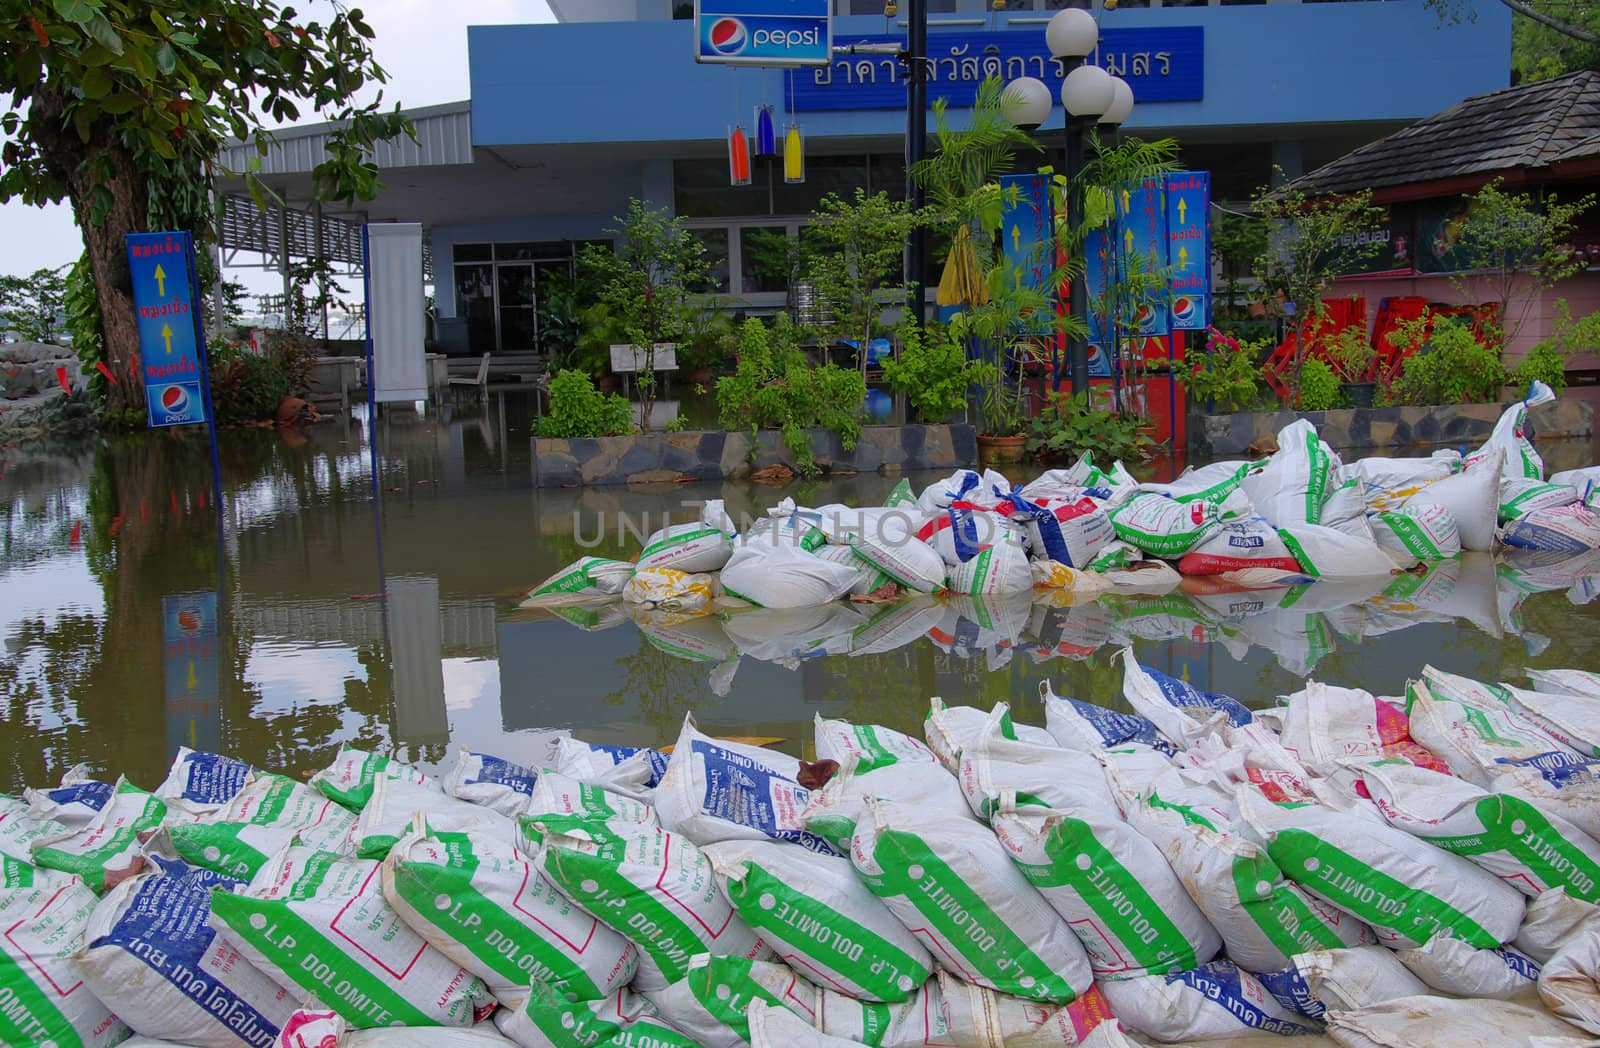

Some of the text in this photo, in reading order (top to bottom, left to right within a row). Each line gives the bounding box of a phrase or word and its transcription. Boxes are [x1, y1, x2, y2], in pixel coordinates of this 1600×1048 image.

[753, 26, 819, 49] pepsi
[1317, 863, 1407, 918] DOLOMITE
[1521, 829, 1595, 896] DOLOMITE
[774, 901, 899, 984] L.P. DOLOMITE
[919, 876, 997, 953] DOLOMITE
[1087, 865, 1160, 945] DOLOMITE
[263, 923, 393, 1026] L.P. DOLOMITE
[448, 901, 572, 992] L.P. DOLOMITE
